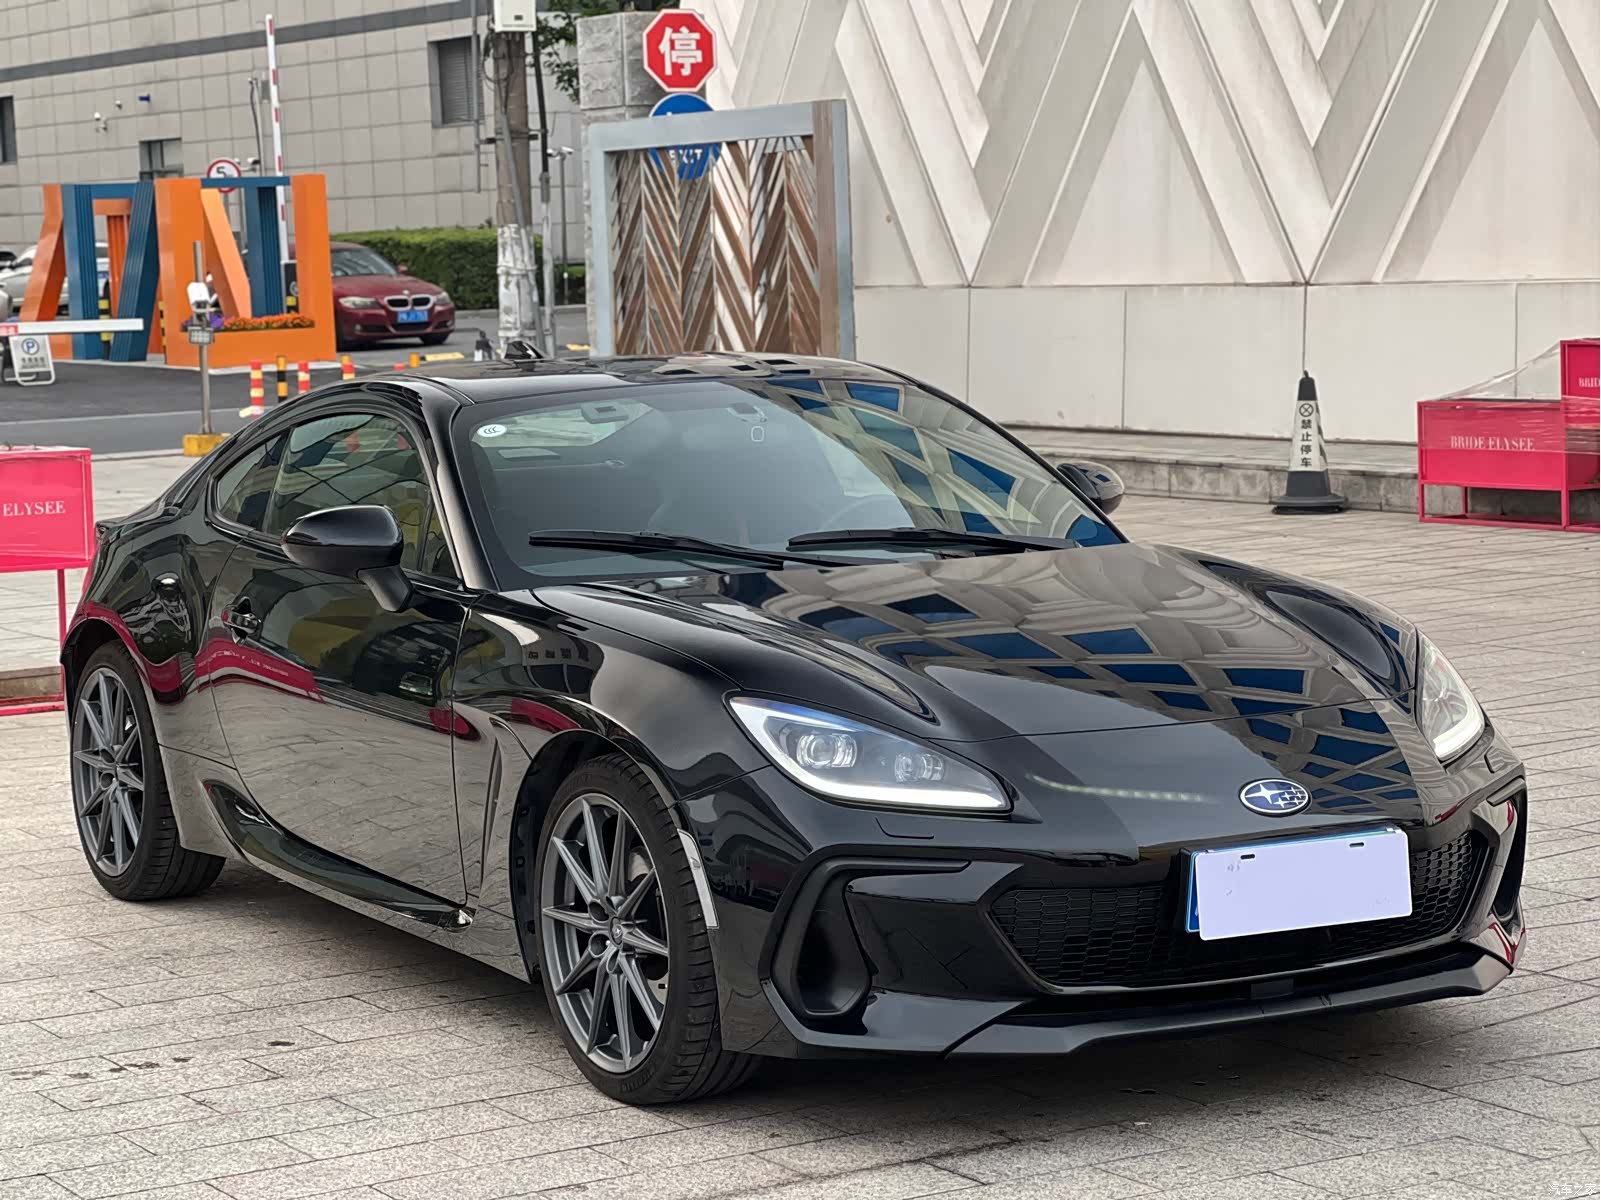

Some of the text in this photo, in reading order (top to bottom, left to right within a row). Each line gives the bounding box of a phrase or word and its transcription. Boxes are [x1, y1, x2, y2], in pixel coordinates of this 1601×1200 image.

[658, 25, 703, 76] 停
[668, 148, 703, 164] EXIT
[1300, 418, 1313, 468] 禁止停车
[1450, 435, 1536, 451] BRIDE ELYSEE
[3, 500, 66, 517] ELYSEE
